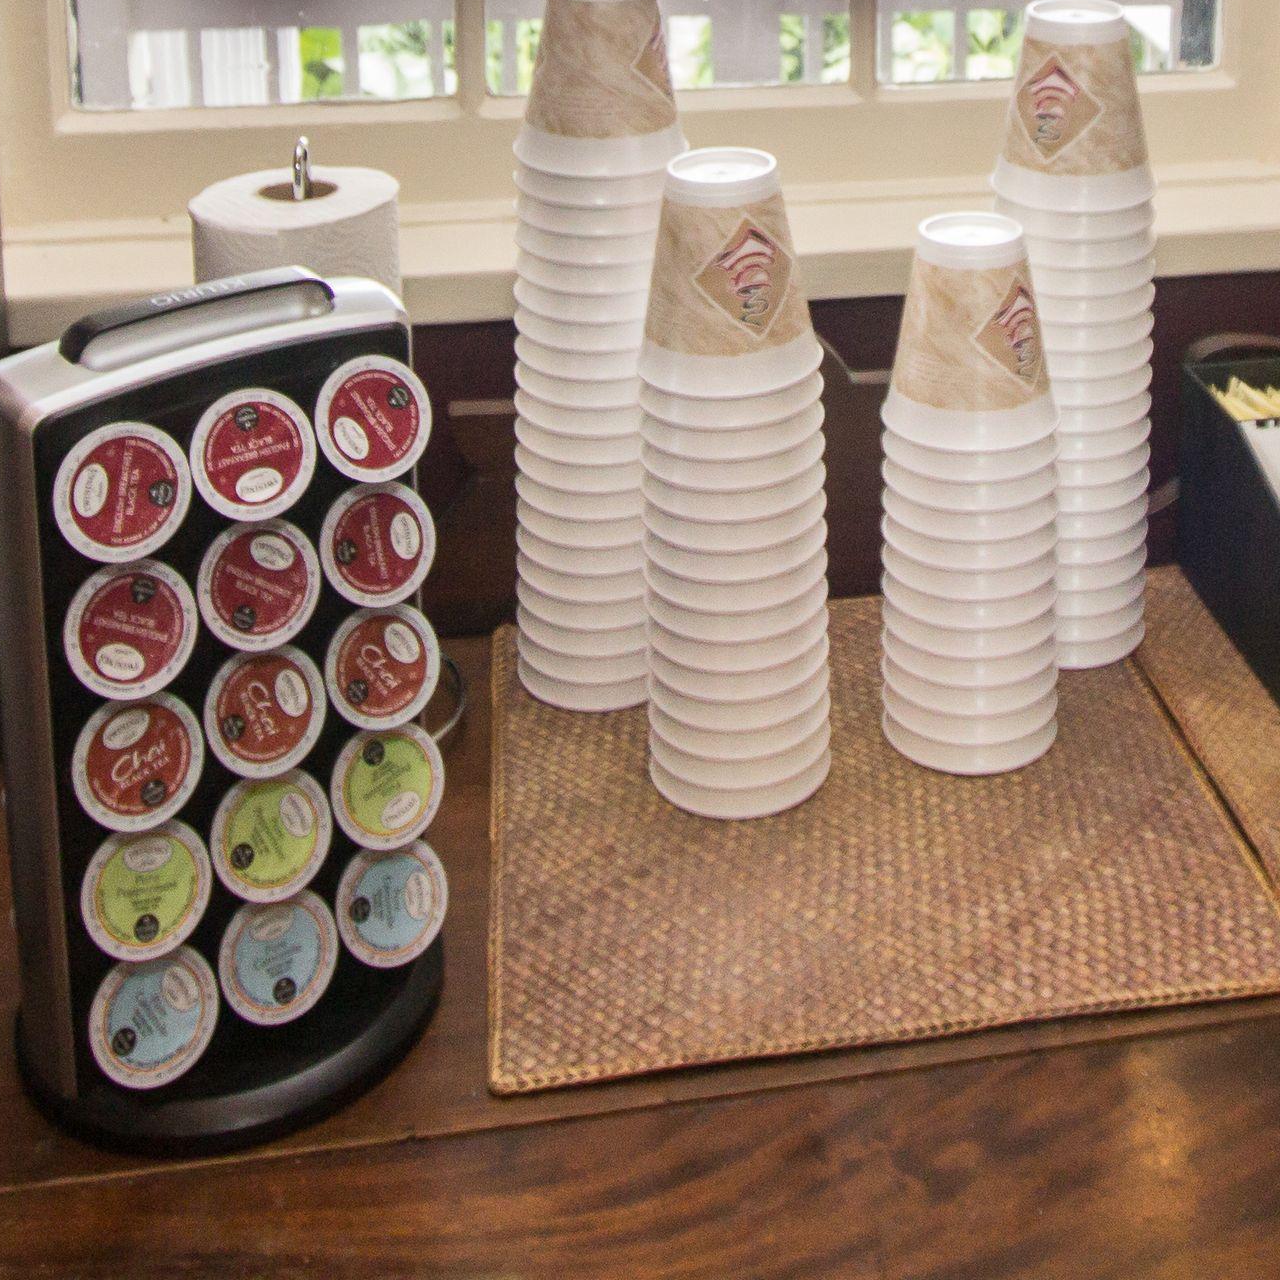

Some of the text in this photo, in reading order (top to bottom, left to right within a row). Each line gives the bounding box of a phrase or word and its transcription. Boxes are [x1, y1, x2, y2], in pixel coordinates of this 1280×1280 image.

[363, 395, 394, 433] BLACK TEA
[229, 434, 273, 453] BLACK TEA
[125, 467, 140, 515] BLACK TEA
[361, 644, 402, 689] Chai
[248, 681, 279, 736] Chai
[111, 738, 165, 783] Chai
